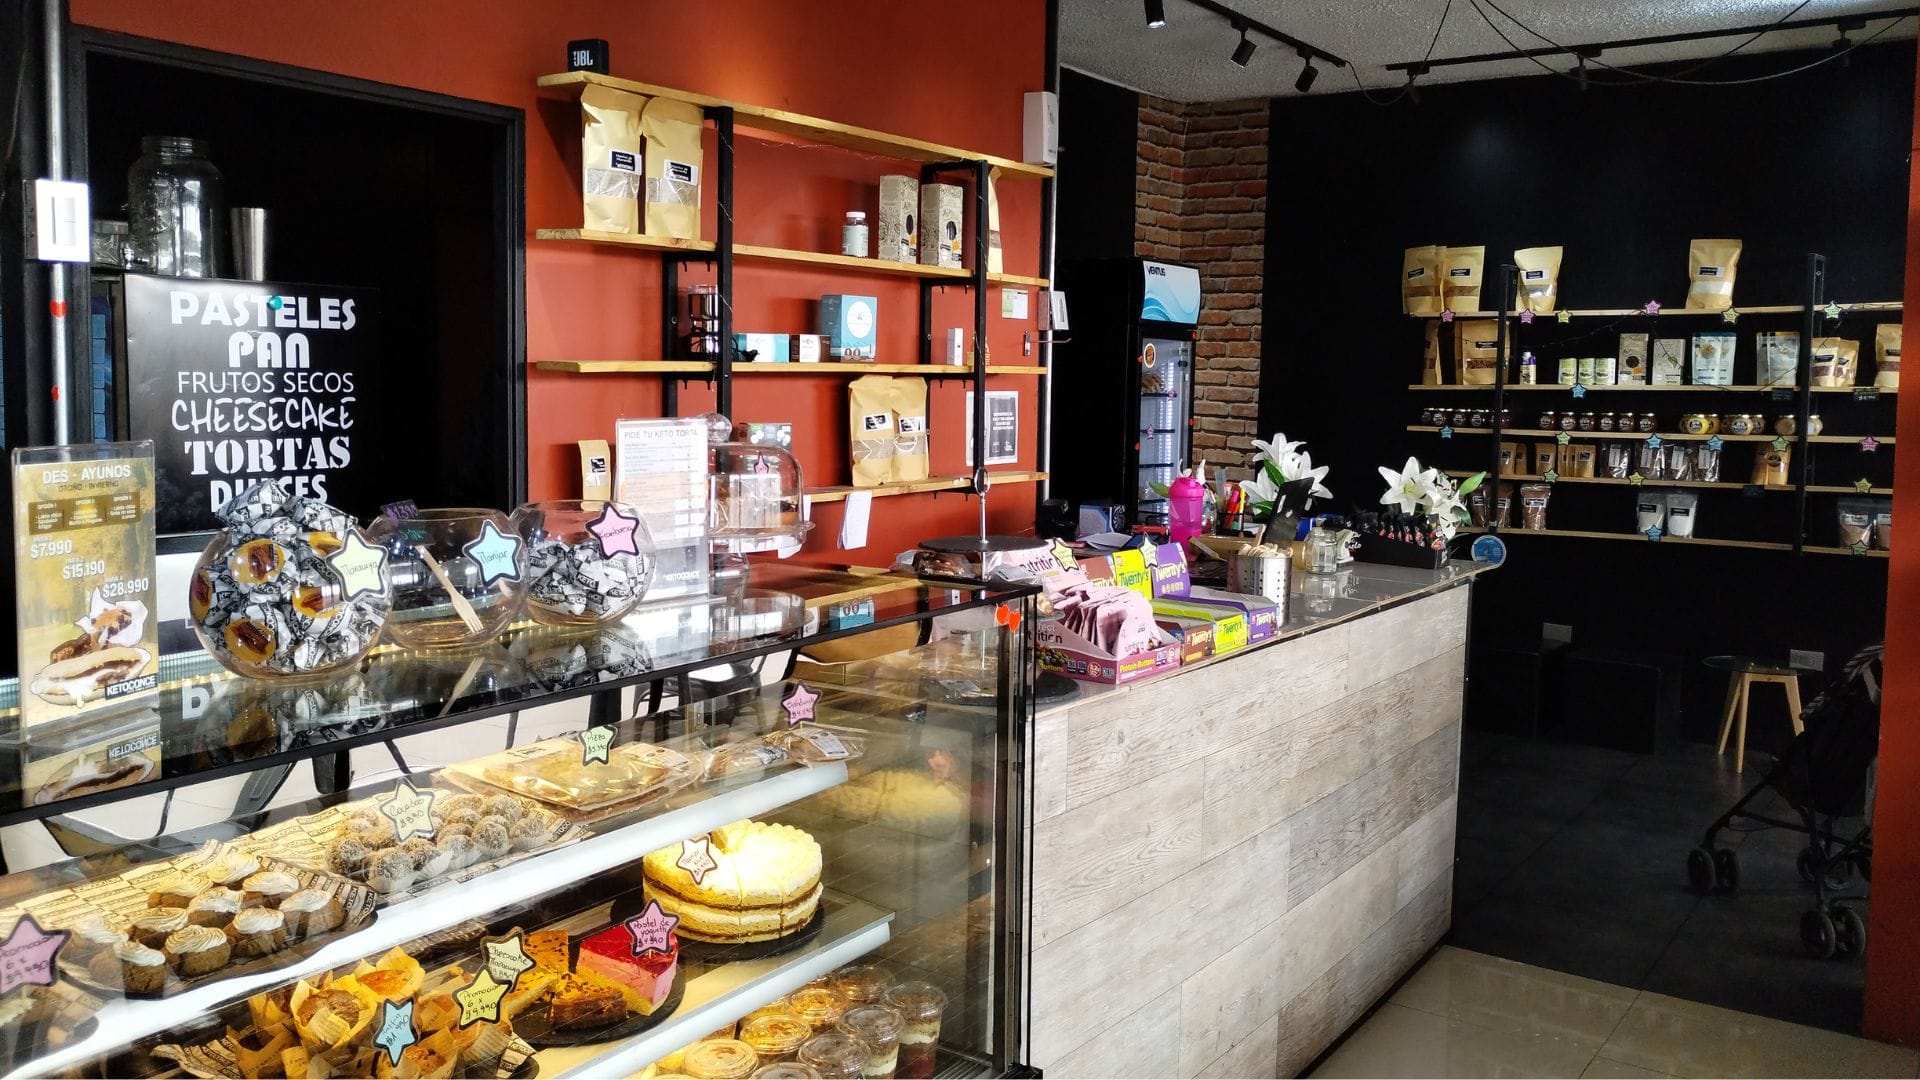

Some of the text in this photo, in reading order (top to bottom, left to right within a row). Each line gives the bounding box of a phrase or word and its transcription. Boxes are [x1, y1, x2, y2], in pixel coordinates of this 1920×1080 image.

[573, 50, 593, 66] JBL
[170, 291, 356, 331] PASTELES
[228, 331, 310, 368] PAN
[177, 372, 354, 394] FRUTOS SECOS
[172, 397, 356, 434] CHEESECAKE
[184, 436, 351, 475] TORTAS
[43, 470, 69, 484] DES
[81, 464, 132, 481] AYUNOS
[210, 474, 328, 513] DCES
[31, 540, 72, 559] $7.990
[63, 560, 105, 580] $15.190
[1118, 570, 1149, 588] Twenty's
[1155, 561, 1188, 582] Twenty's
[102, 577, 149, 598] $28.990
[107, 676, 156, 696] KETOCONCE
